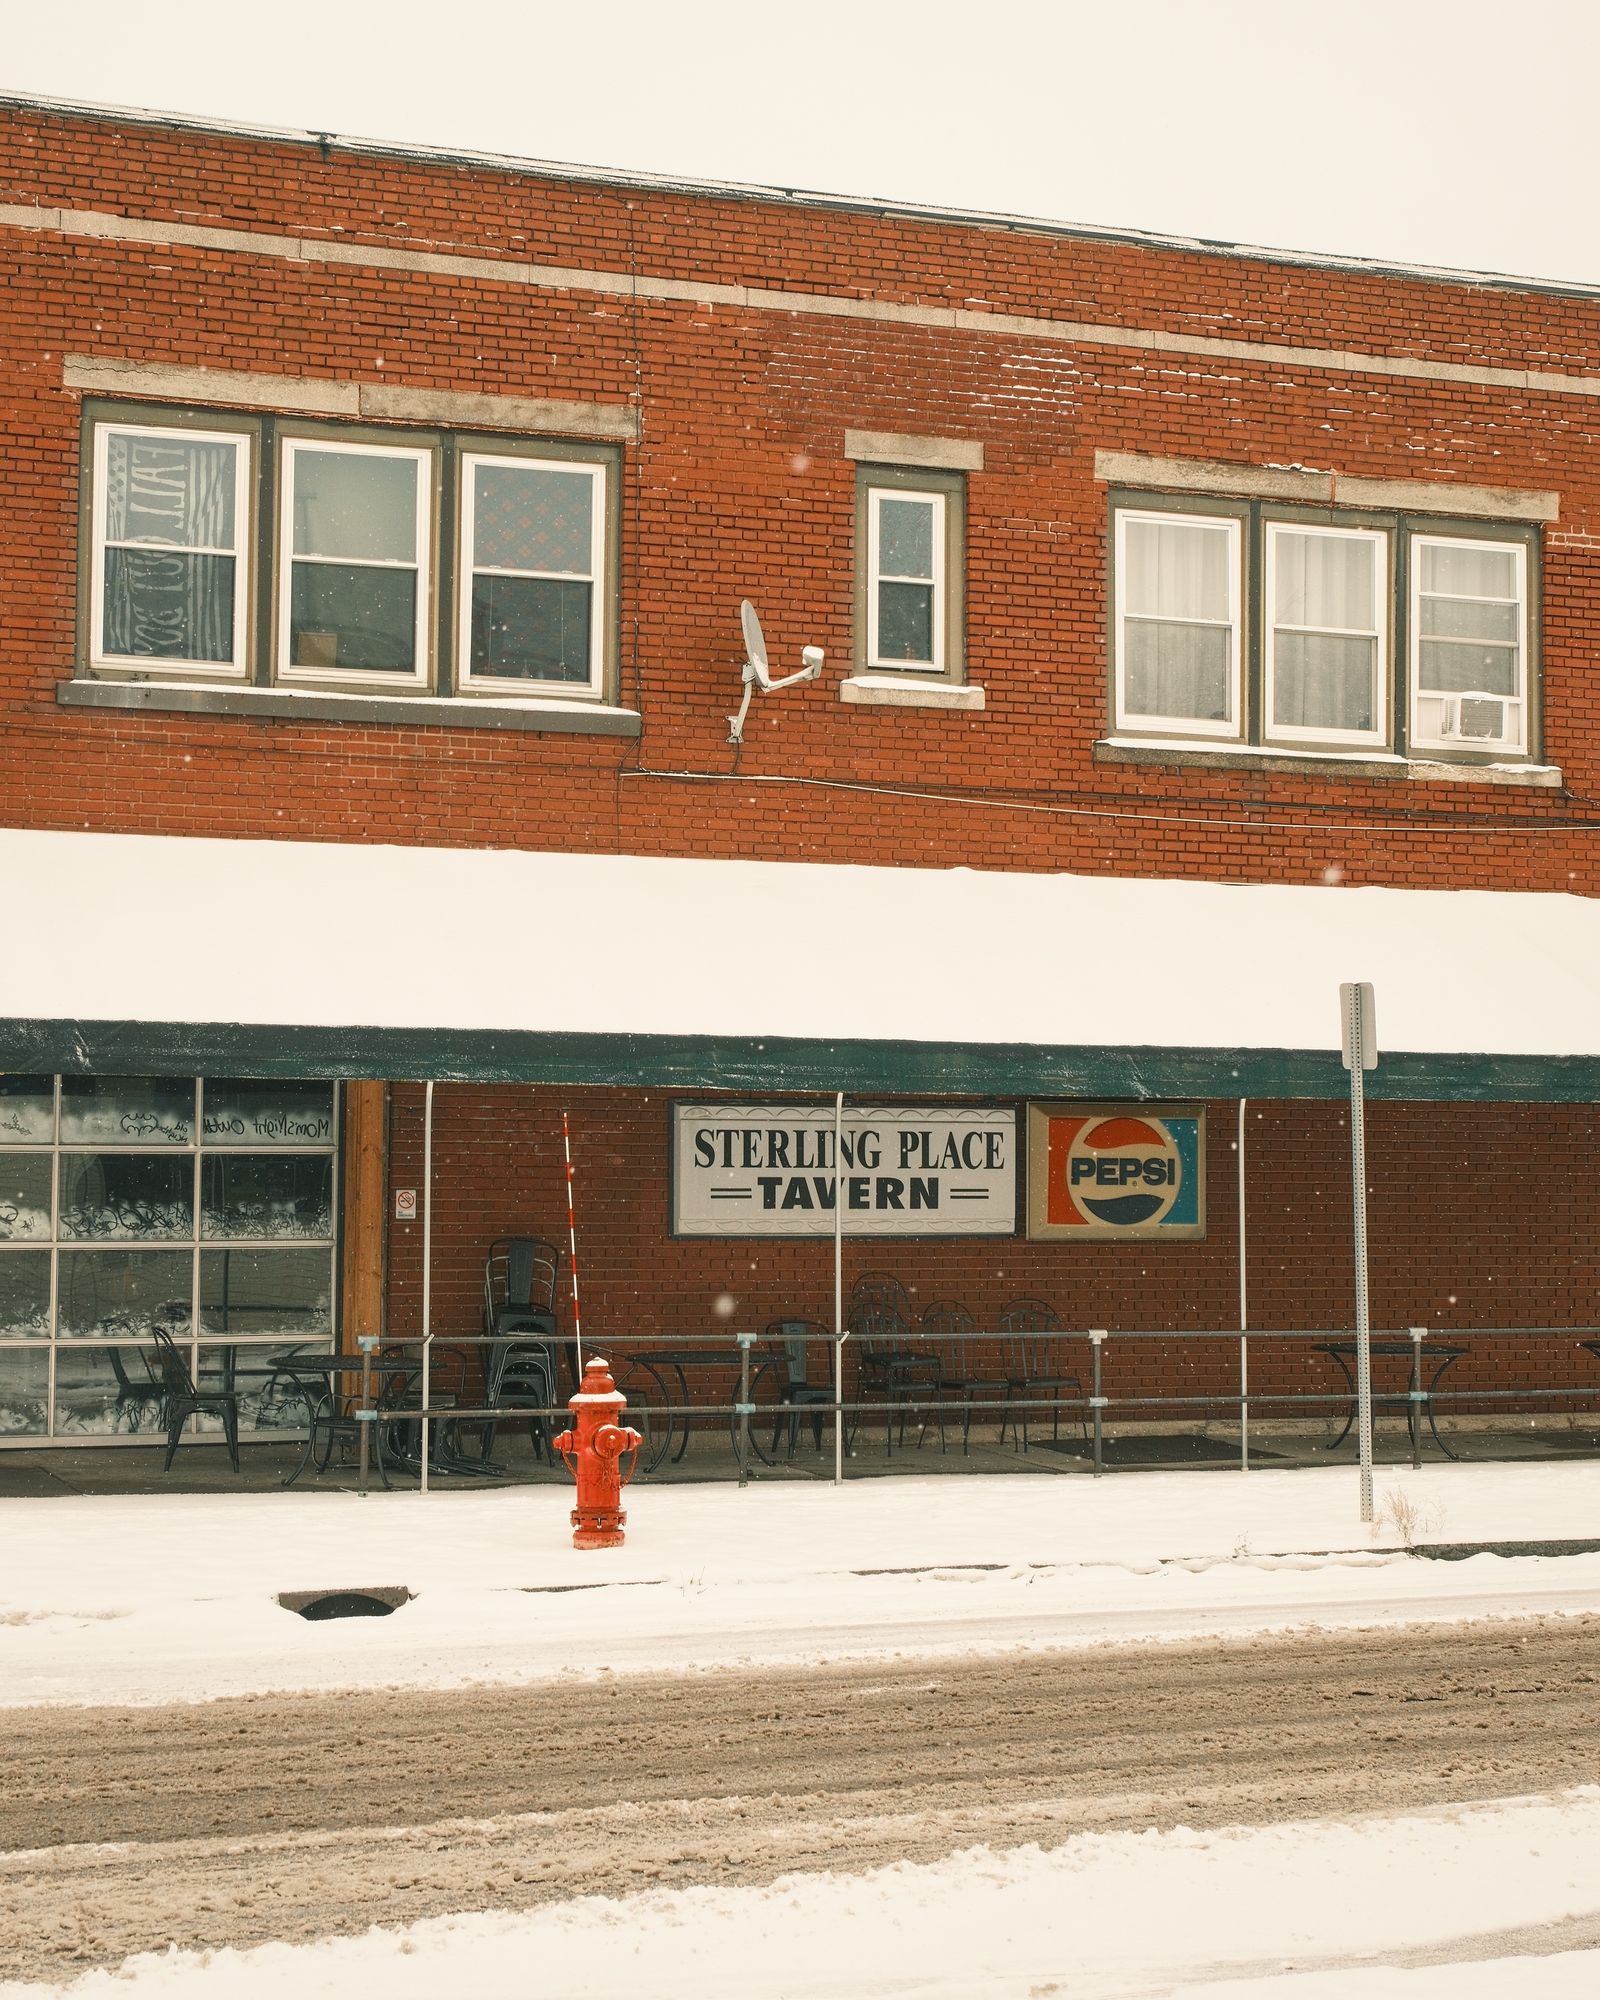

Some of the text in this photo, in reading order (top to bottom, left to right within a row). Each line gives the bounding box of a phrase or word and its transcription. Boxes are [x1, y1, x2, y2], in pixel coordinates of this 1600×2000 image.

[694, 1128, 1005, 1170] STERLING PLACE
[1070, 1157, 1175, 1186] PEPSI
[758, 1176, 939, 1210] TAVERN
